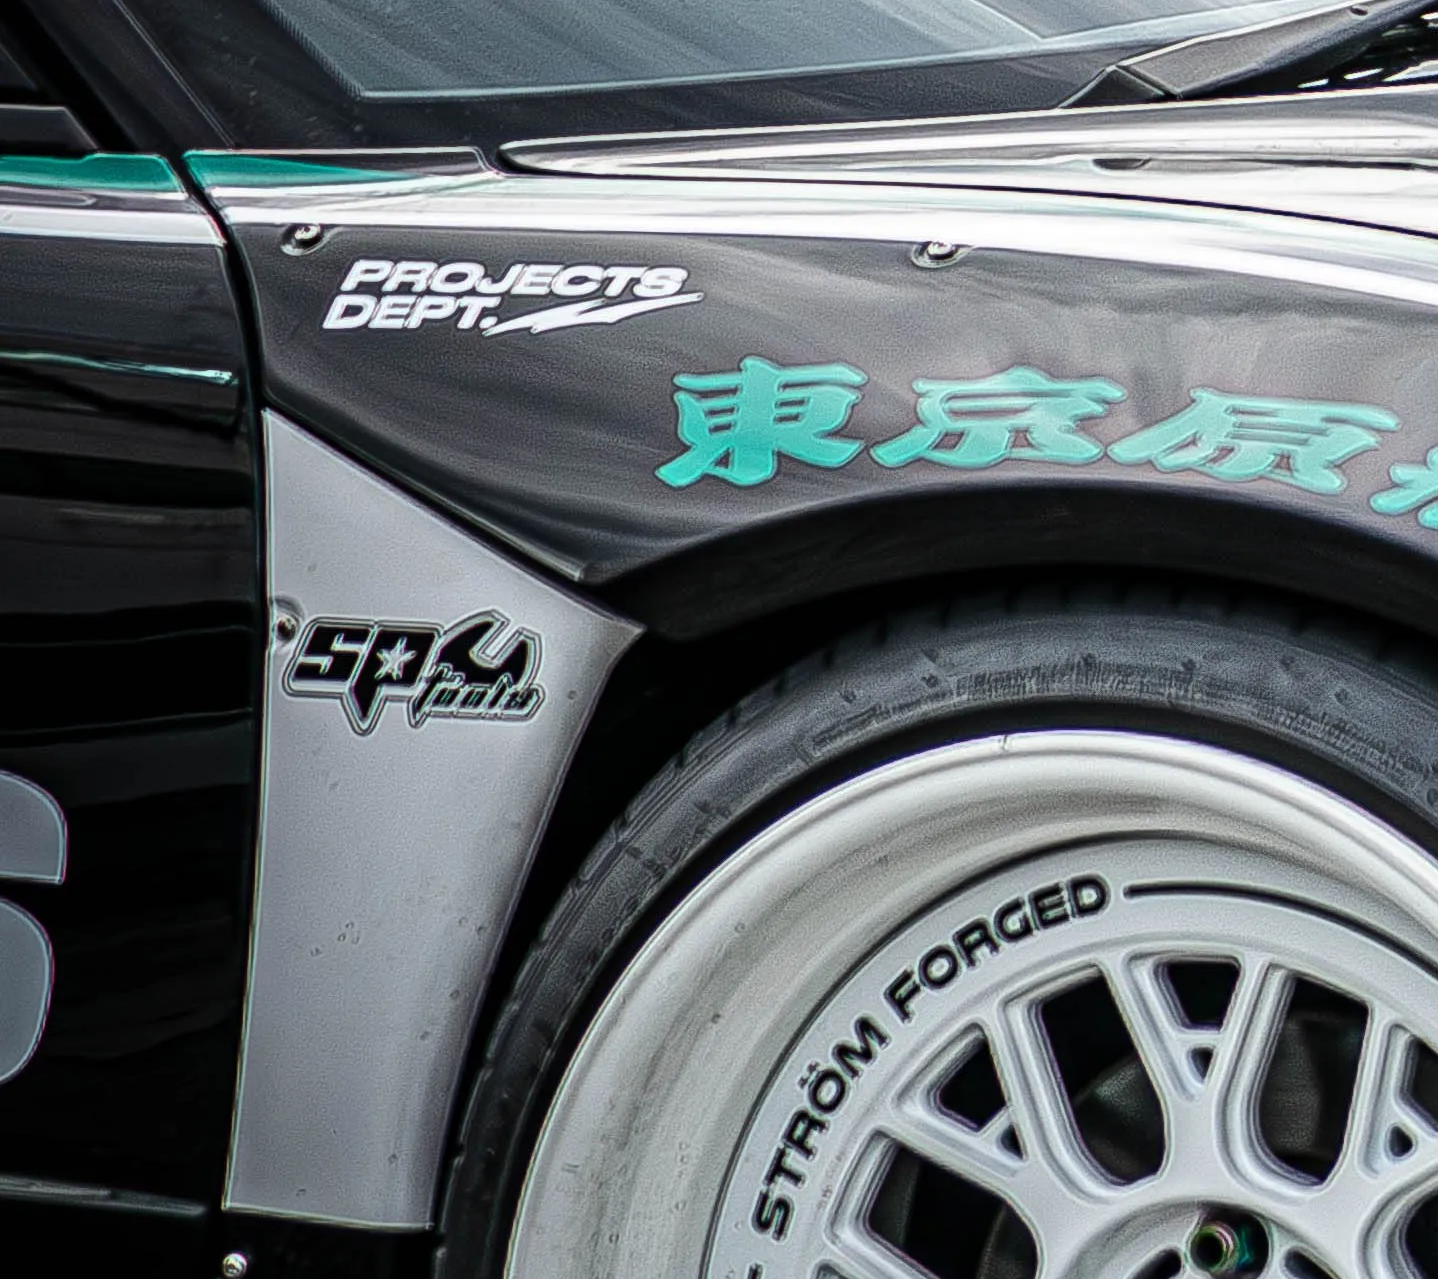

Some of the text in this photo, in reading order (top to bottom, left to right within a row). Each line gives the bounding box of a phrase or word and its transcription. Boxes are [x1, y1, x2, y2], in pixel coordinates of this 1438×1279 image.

[340, 259, 689, 294] PROJECTS
[321, 294, 500, 330] DEPT.
[290, 623, 438, 726] SP
[751, 1015, 892, 1242] STRÖM
[883, 873, 1113, 1024] FORGED
